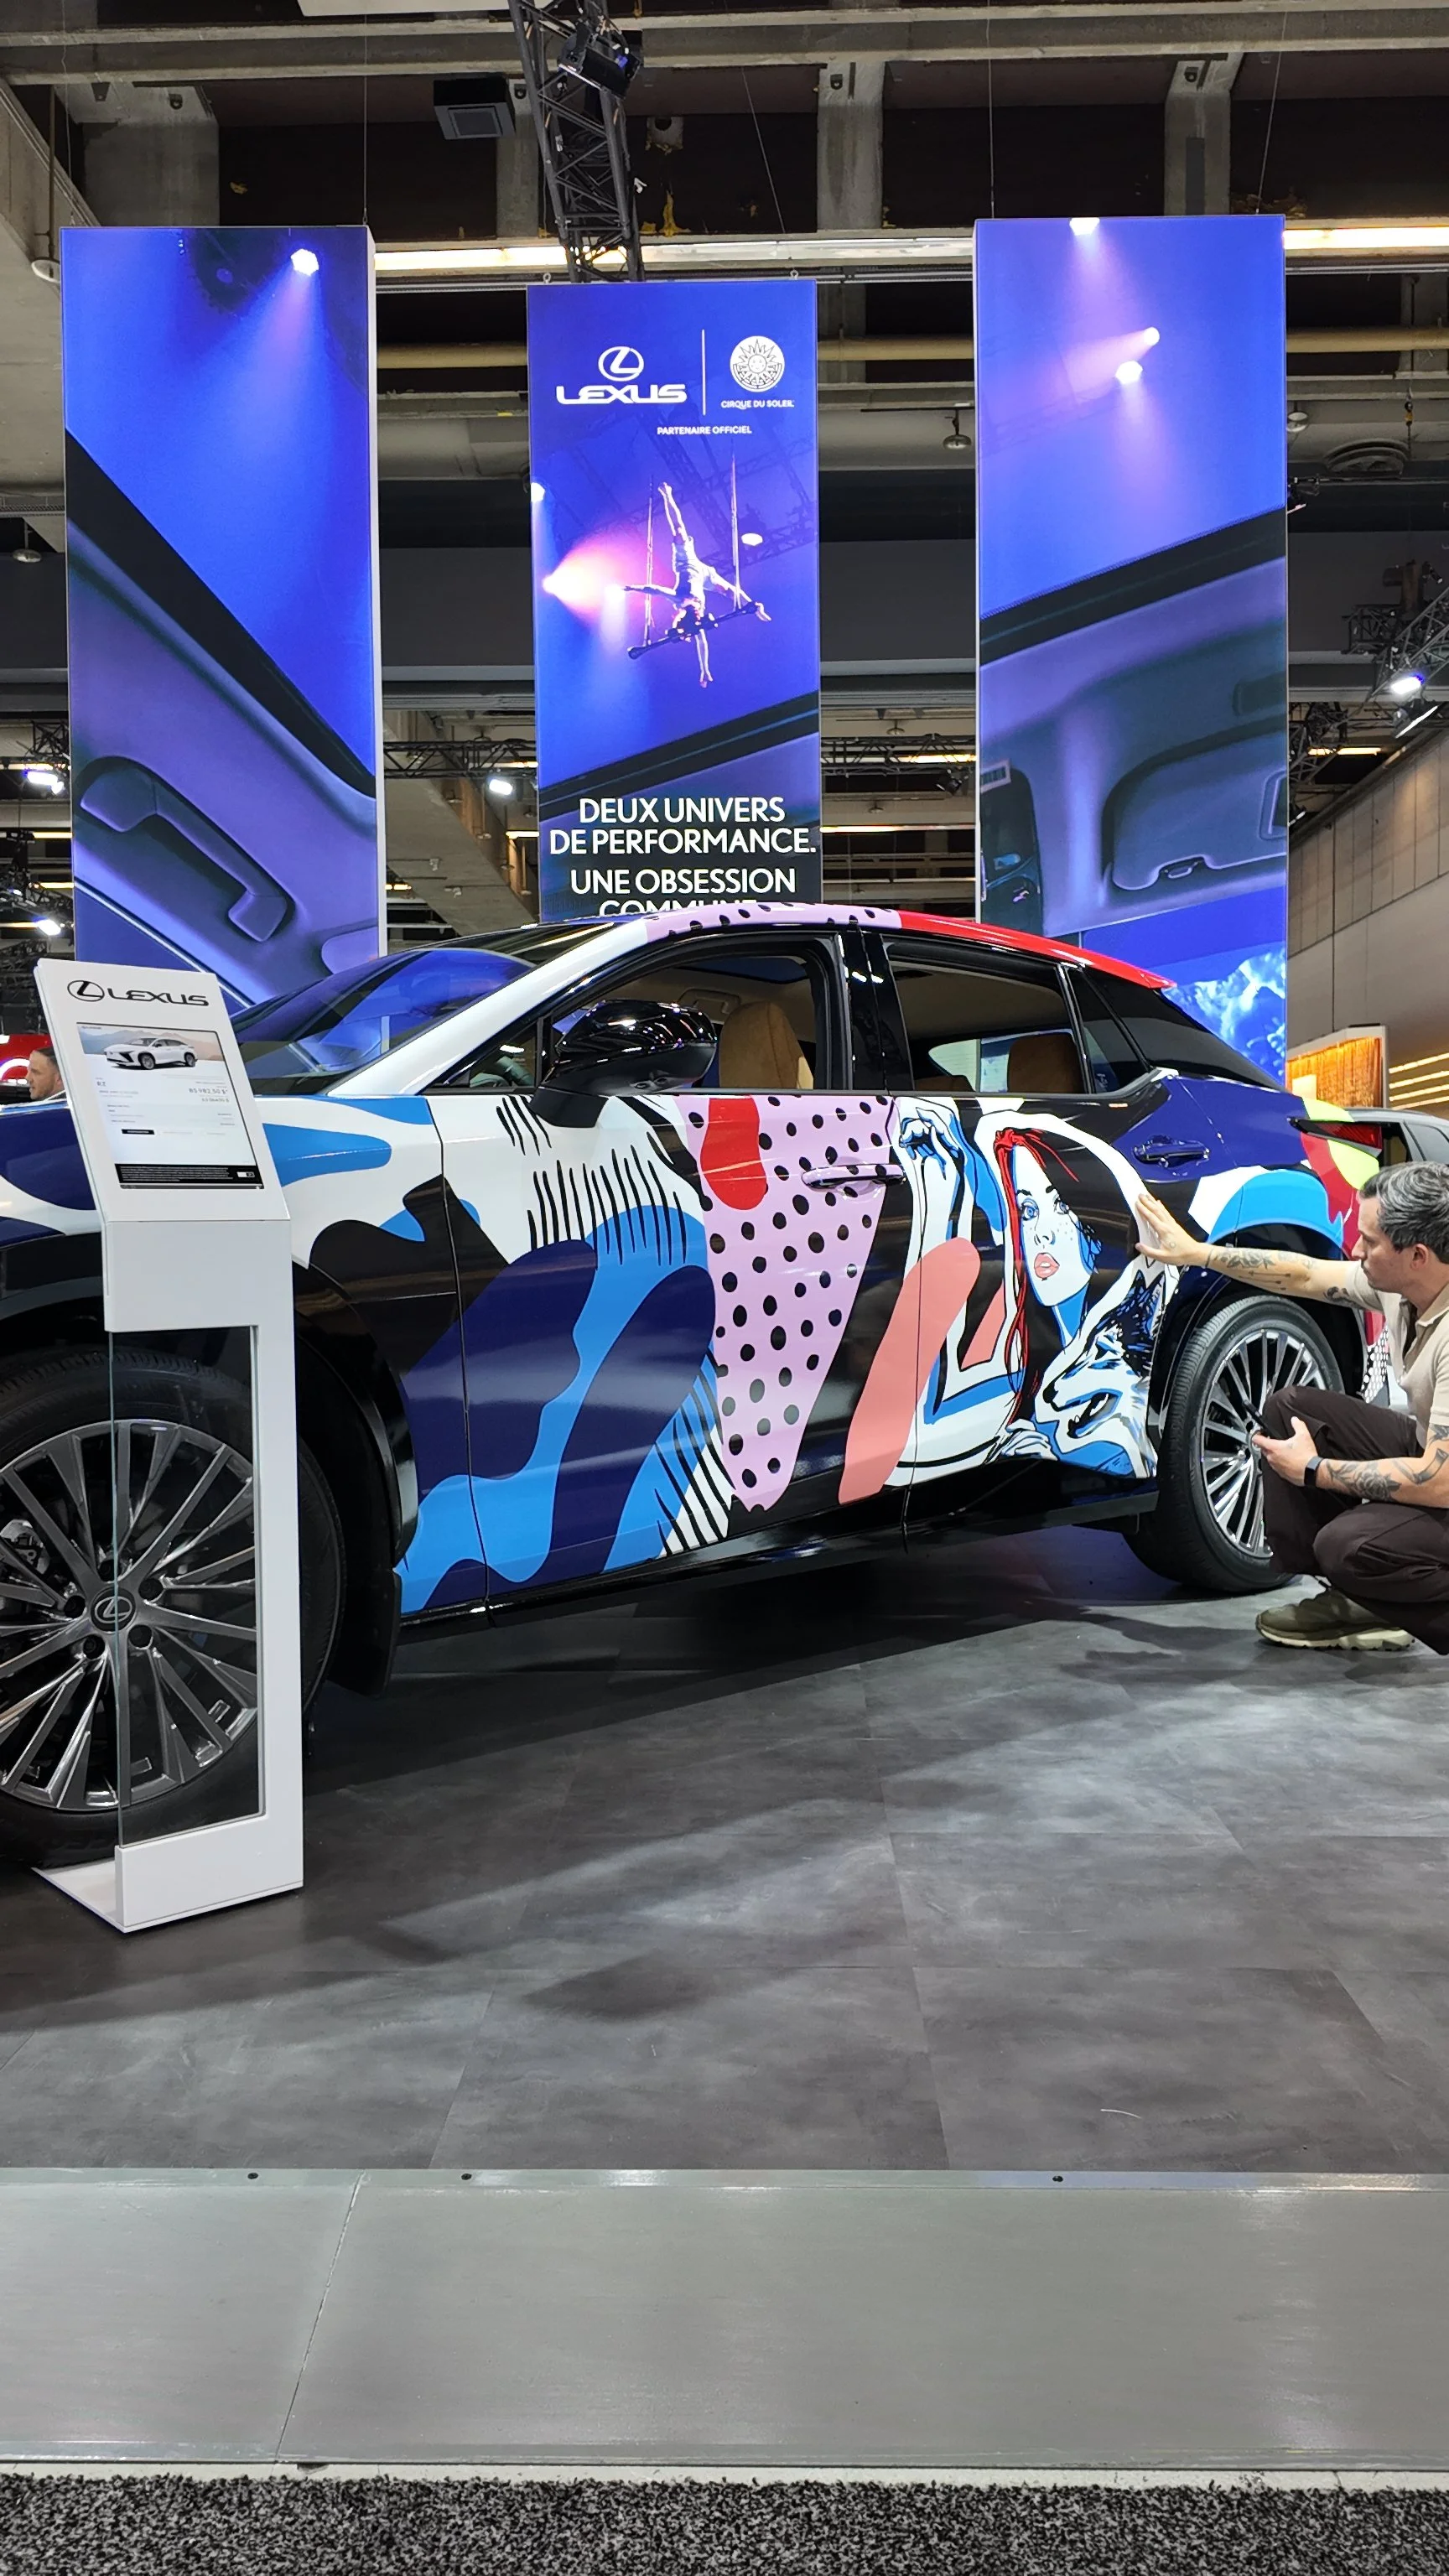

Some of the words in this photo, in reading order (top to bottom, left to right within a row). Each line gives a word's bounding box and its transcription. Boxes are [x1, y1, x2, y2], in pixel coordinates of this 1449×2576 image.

[556, 383, 687, 404] LEXUS
[721, 400, 751, 410] CIRQUE
[766, 399, 794, 408] SOLEIL
[657, 426, 711, 435] PARTENAIRE
[712, 425, 752, 434] OFFICIEL
[579, 797, 659, 823] DEUX
[664, 797, 785, 823] UNIVERS
[549, 829, 587, 855] DE
[592, 828, 817, 854] PERFORMANCE.
[570, 869, 631, 895] UNE
[635, 868, 796, 895] OBSESSION
[107, 988, 209, 1006] LEXUS
